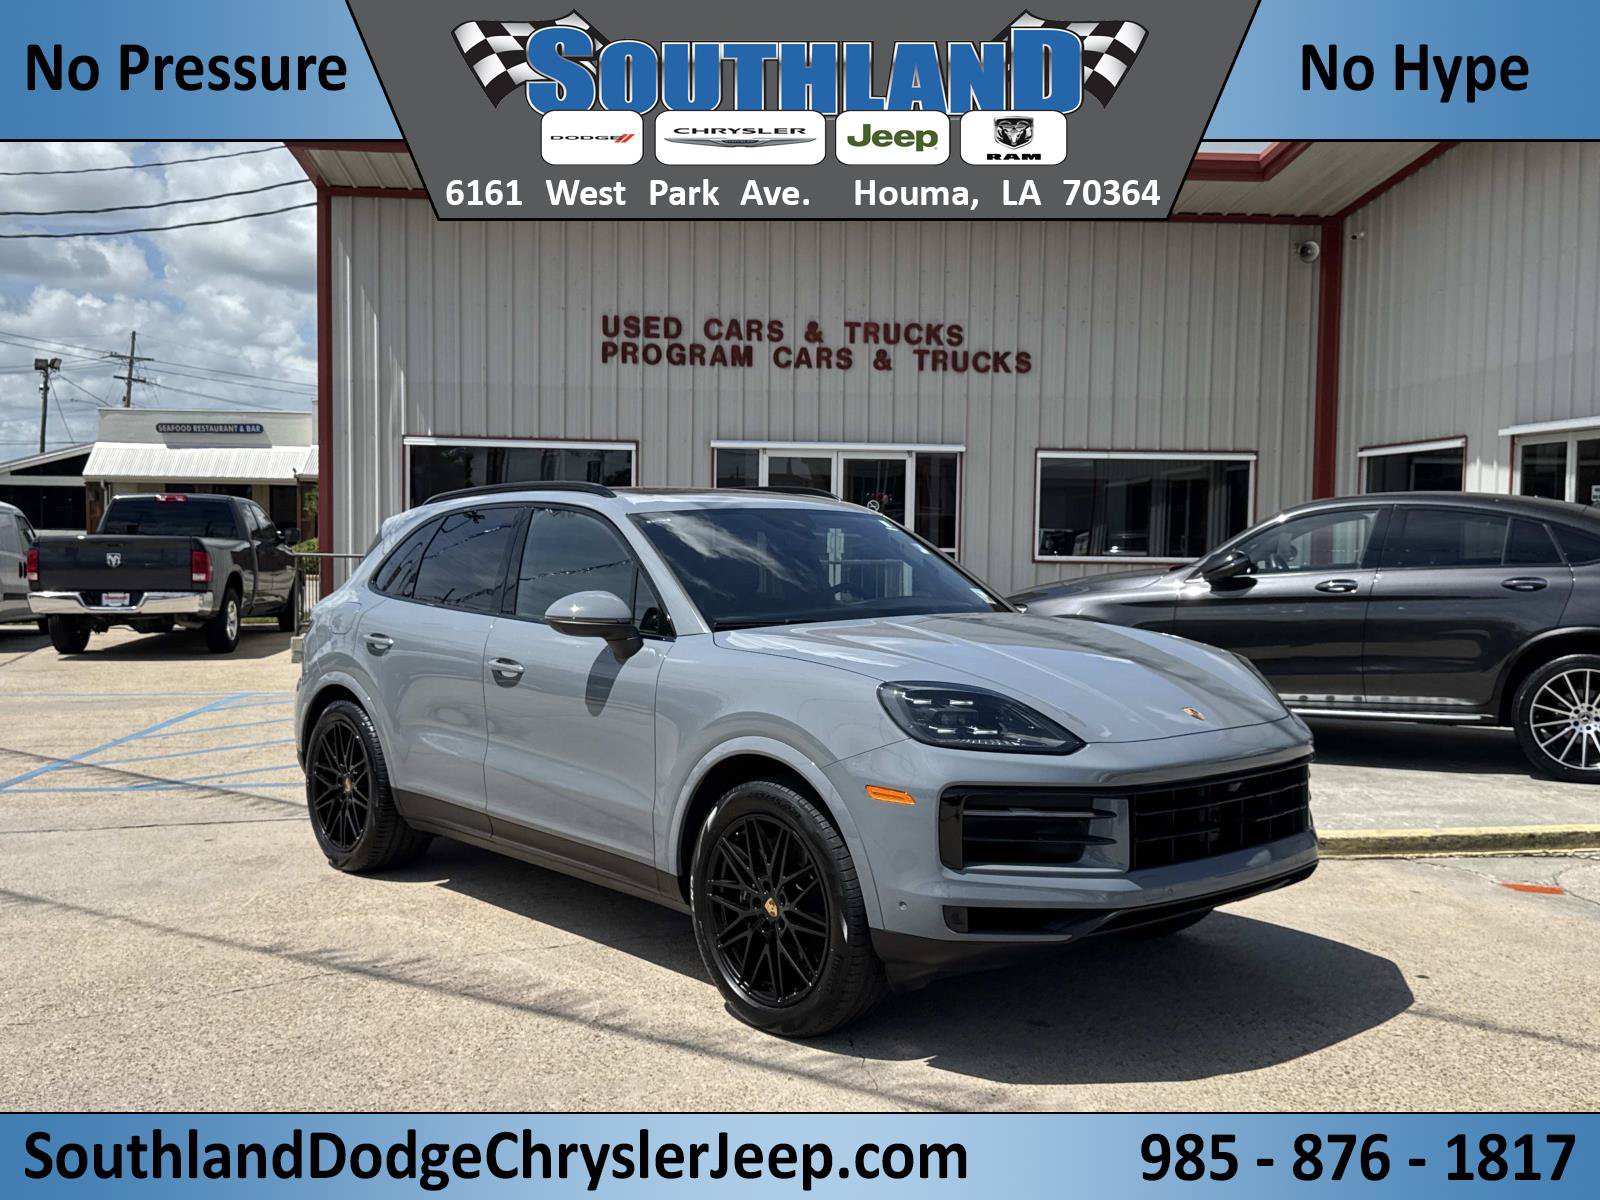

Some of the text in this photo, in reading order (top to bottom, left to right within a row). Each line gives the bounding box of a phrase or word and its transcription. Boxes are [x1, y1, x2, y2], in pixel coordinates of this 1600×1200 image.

[602, 314, 964, 347] USED CARS & TRUCKS
[601, 341, 1032, 374] PROGRAM CARS & TRUCKS
[158, 424, 191, 432] SEAFOOD
[193, 424, 238, 433] RESTAURANT
[246, 425, 261, 433] BAR
